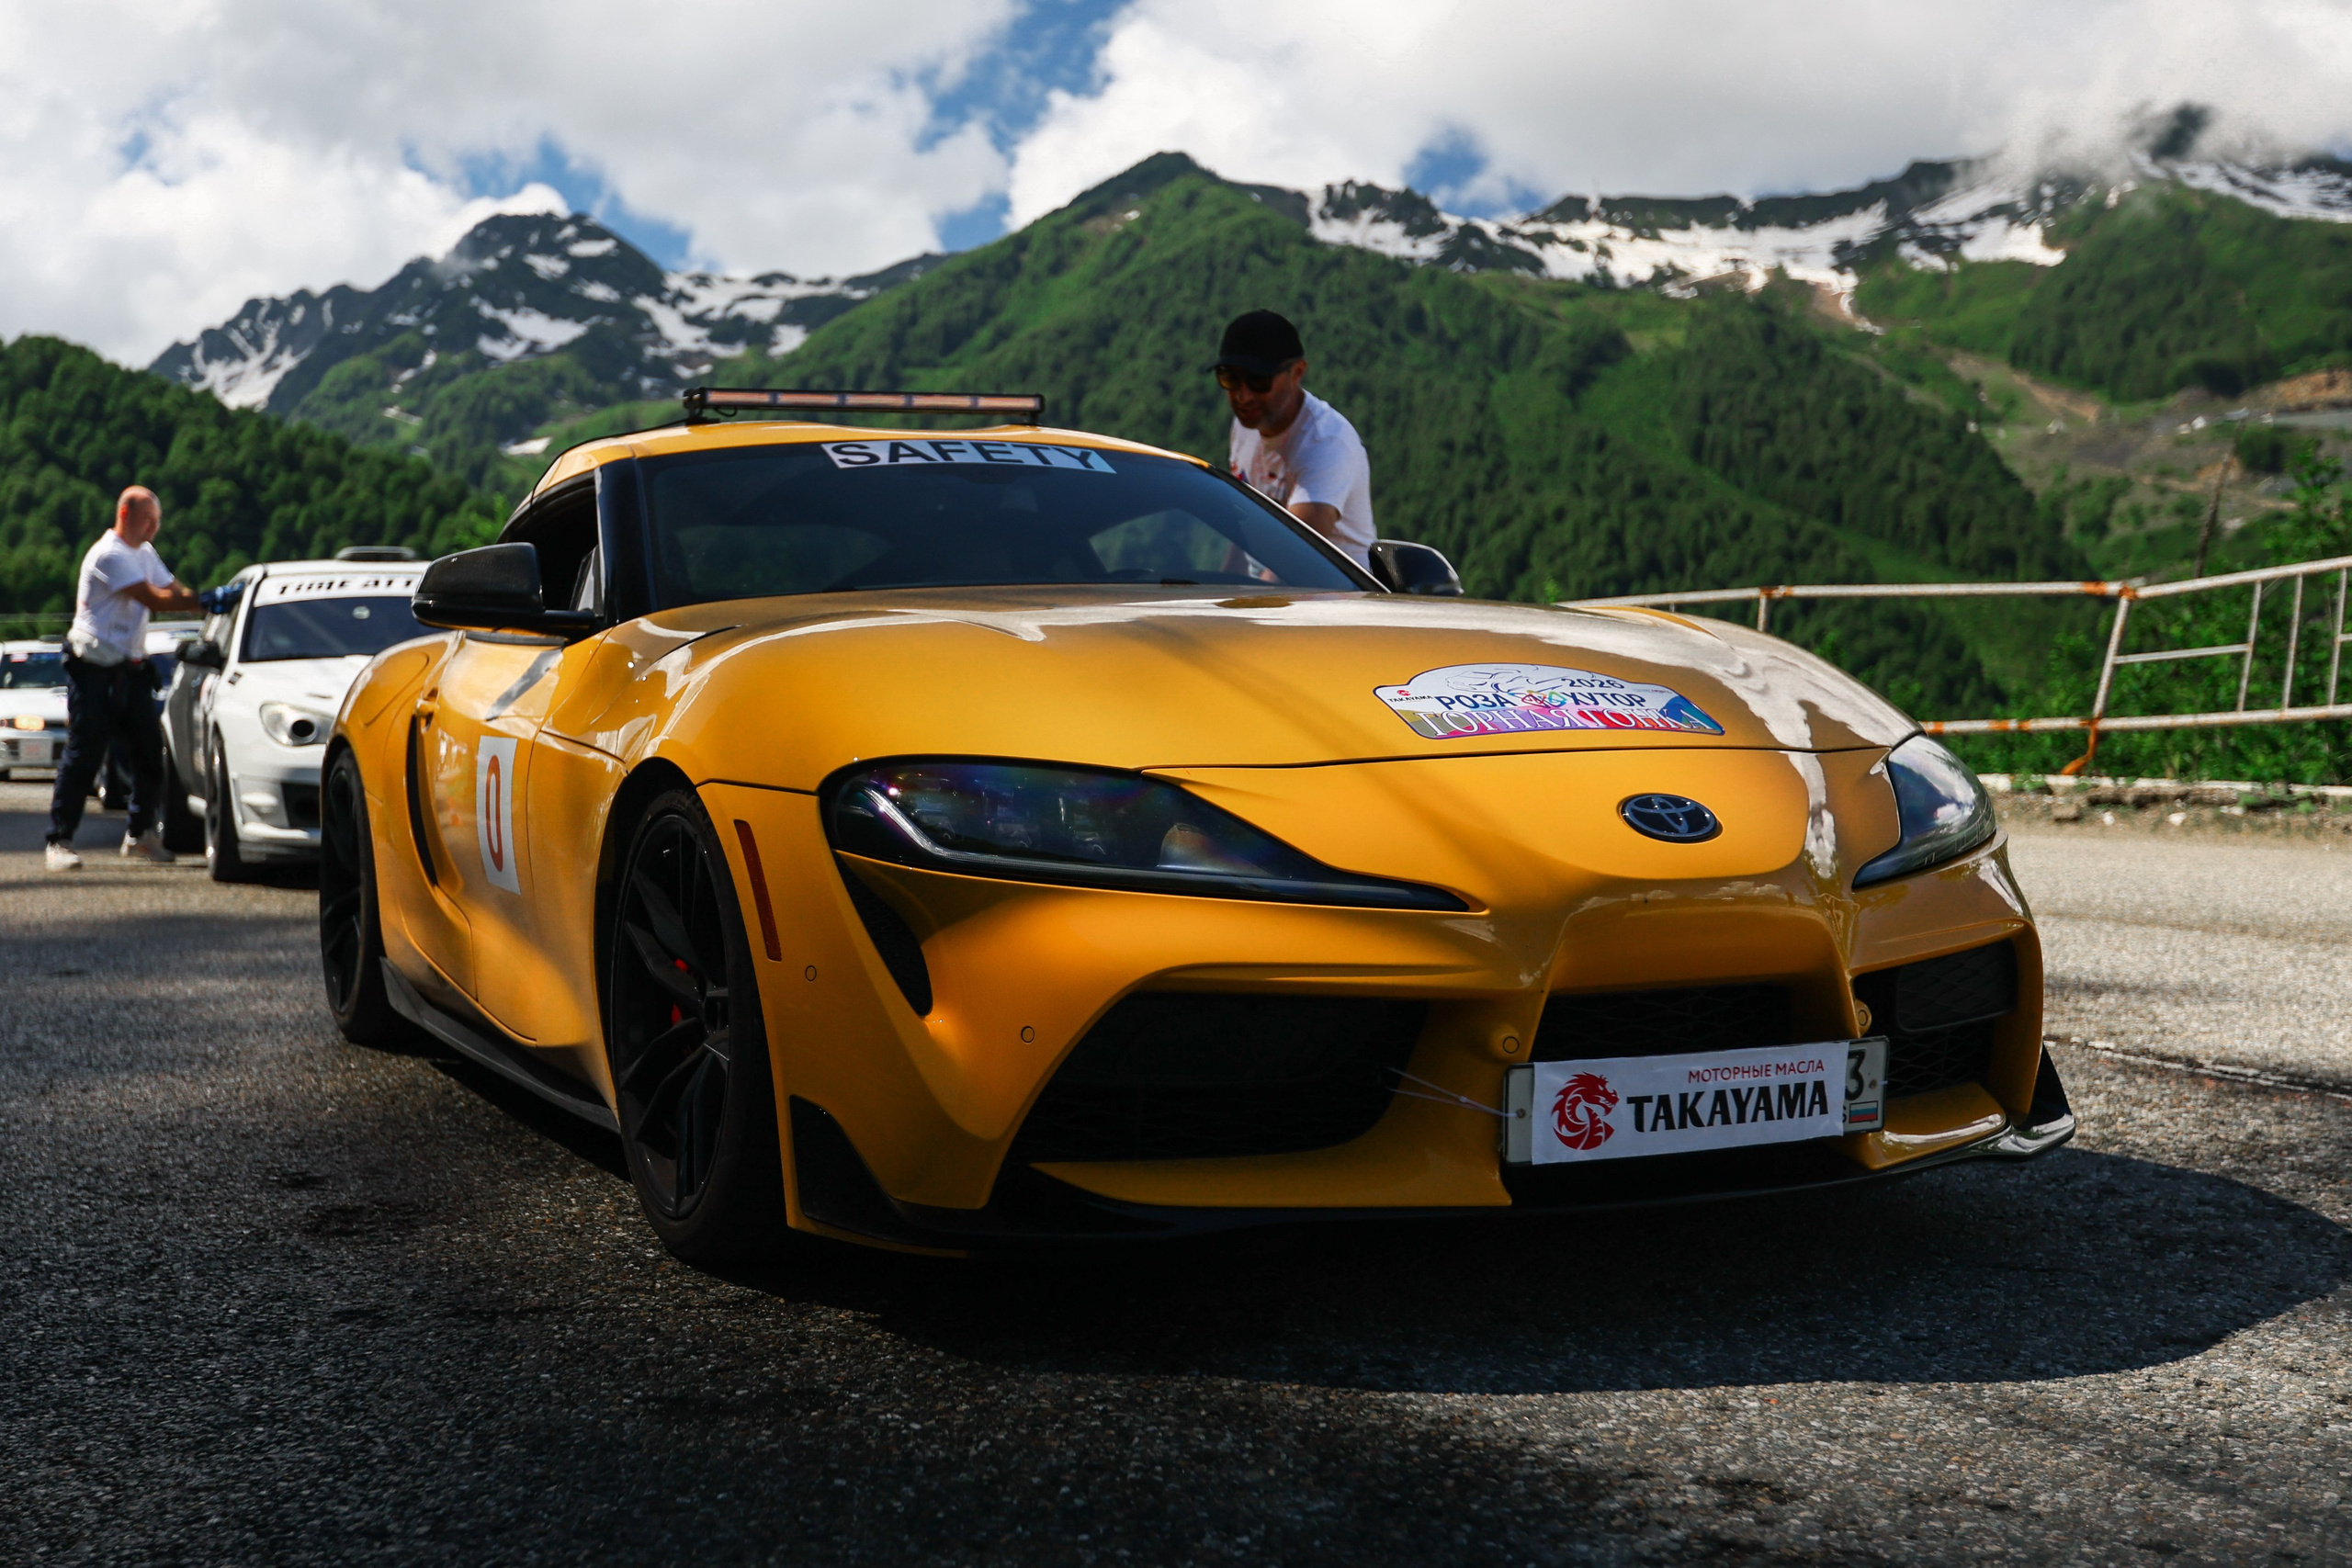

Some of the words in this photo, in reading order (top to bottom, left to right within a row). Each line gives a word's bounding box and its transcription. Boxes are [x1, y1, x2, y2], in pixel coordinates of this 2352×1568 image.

[831, 441, 1095, 469] SAFETY
[362, 579, 413, 588] ATT
[1562, 678, 1625, 689] 2026
[1435, 693, 1518, 710] РОЗА
[1561, 692, 1645, 707] ХУТОР
[1413, 708, 1582, 736] ГОРНАЯ
[1580, 708, 1716, 730] ГОНКА
[486, 754, 503, 872] 0
[1688, 1064, 1771, 1083] МОТОРНЫЕ
[1775, 1058, 1825, 1076] МАСЛА
[1626, 1079, 1828, 1133] TAKAYAMA
